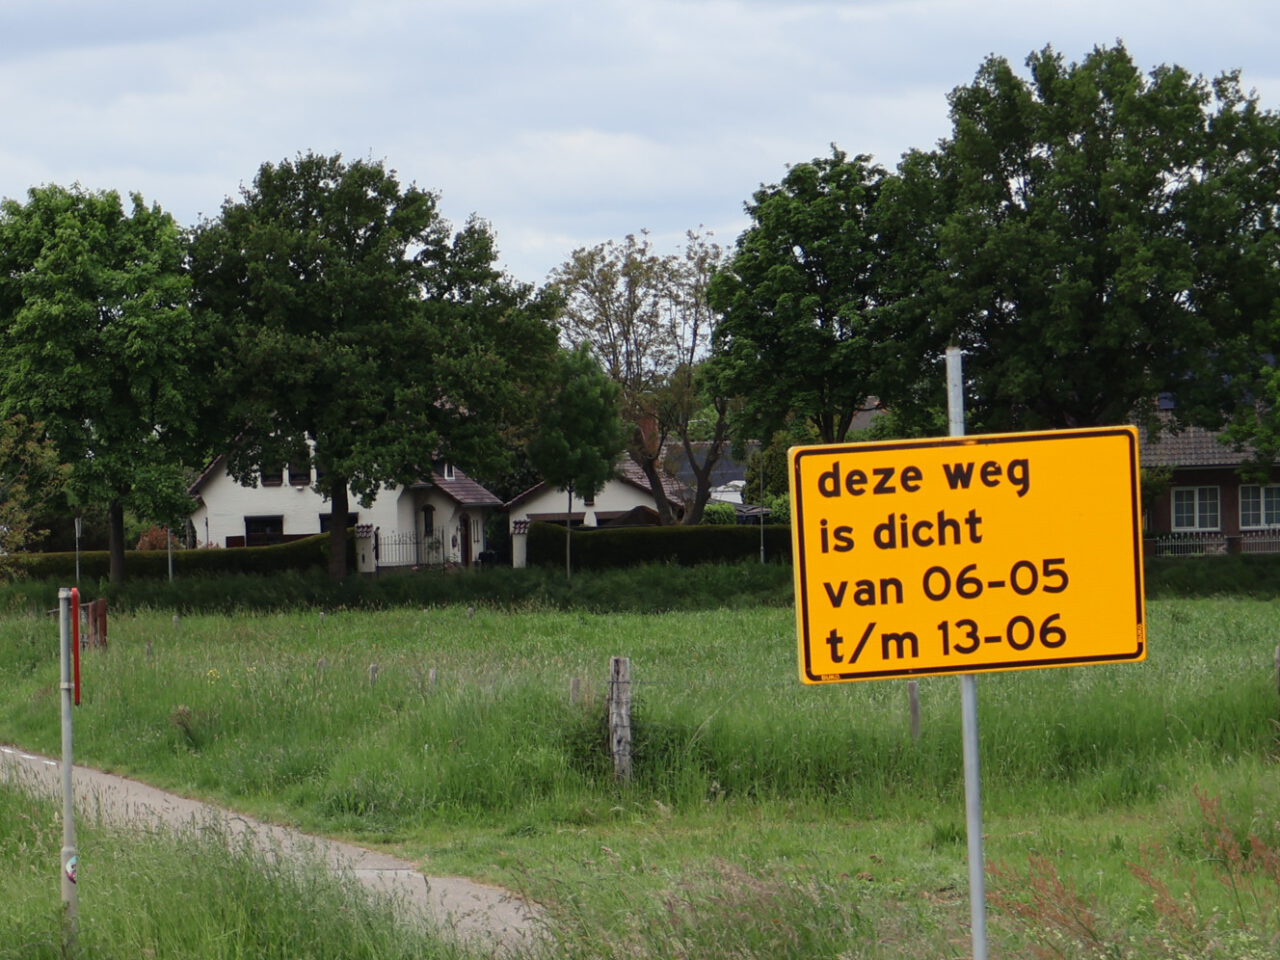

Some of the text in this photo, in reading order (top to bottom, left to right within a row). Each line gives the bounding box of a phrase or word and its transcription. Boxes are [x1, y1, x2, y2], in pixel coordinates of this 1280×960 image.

[817, 458, 1031, 498] deze weg
[819, 508, 983, 554] is dicht
[823, 558, 1070, 608] van 06-05
[825, 612, 1068, 664] t/m 13-06
